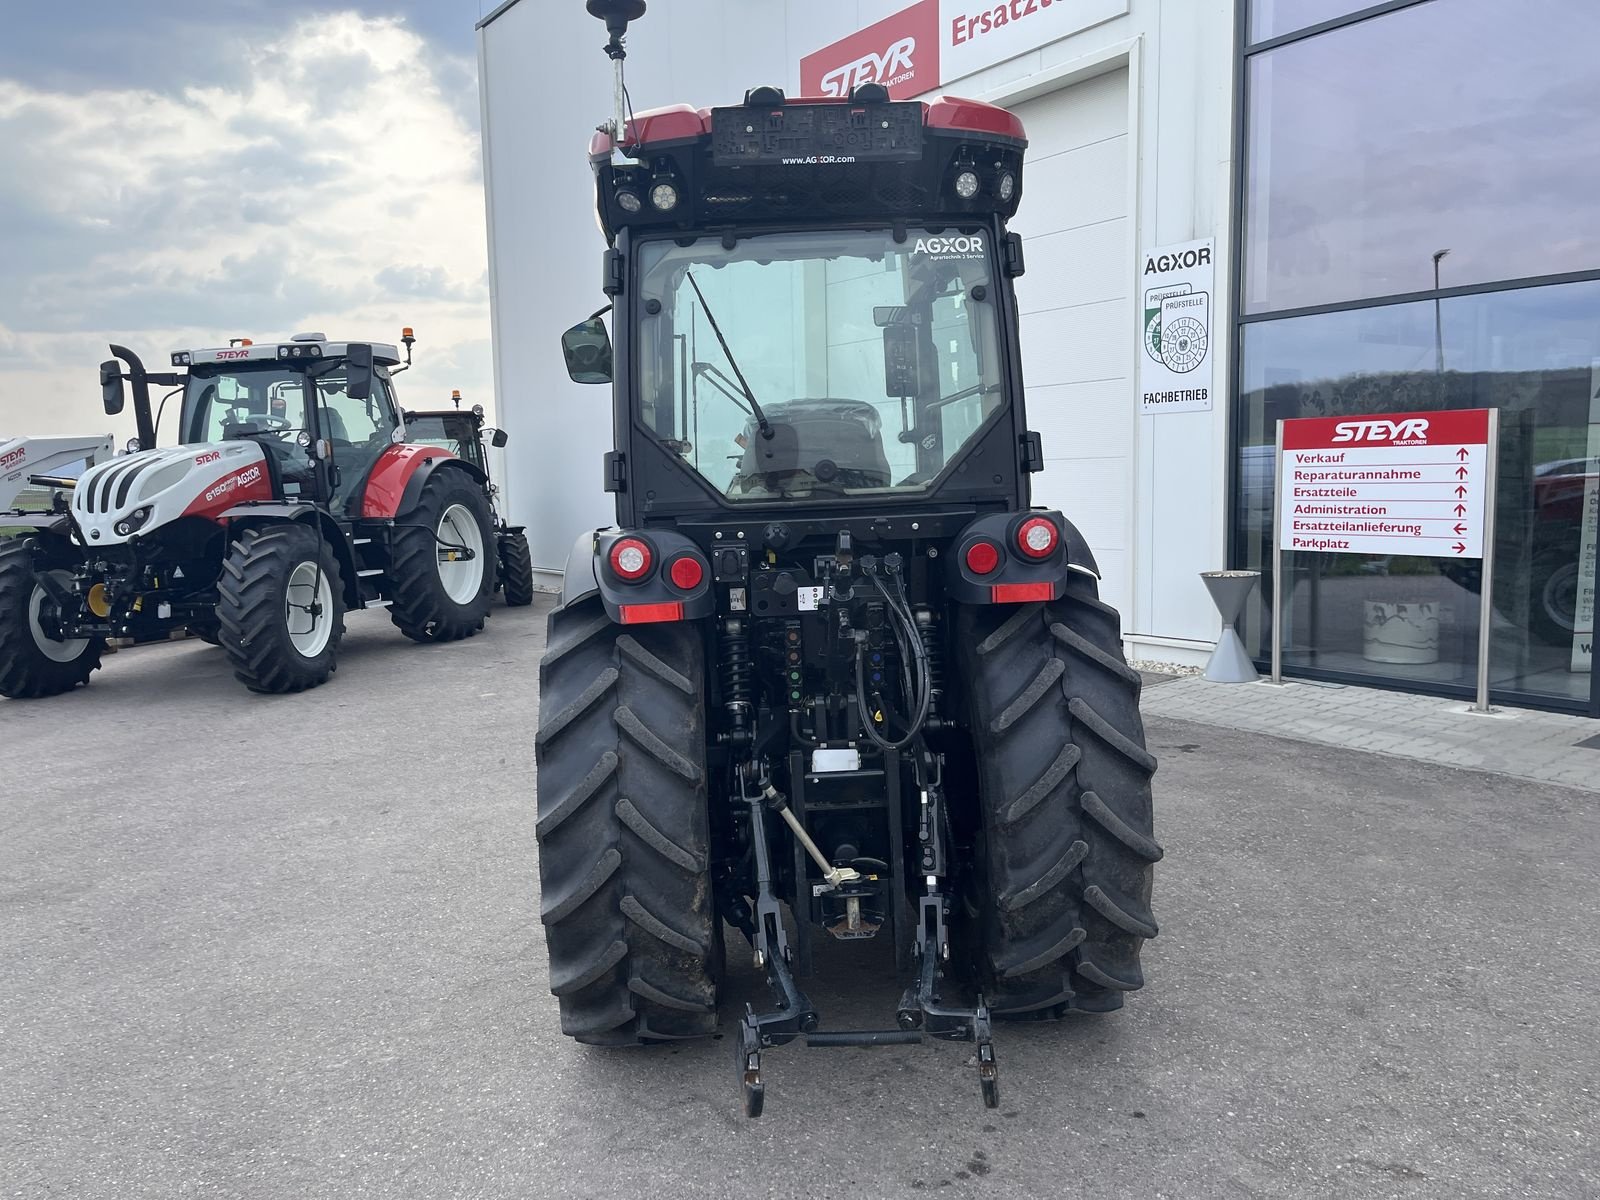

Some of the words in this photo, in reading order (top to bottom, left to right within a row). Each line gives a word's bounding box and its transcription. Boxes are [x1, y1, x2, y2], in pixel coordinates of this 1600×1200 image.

[821, 36, 915, 97] STEYR
[881, 70, 915, 87] RAKTOREN
[914, 237, 983, 254] AGXOR
[1144, 247, 1211, 275] AGXOR
[1165, 297, 1204, 310] PRÜFSTELLE
[216, 350, 249, 360] STEYR
[1143, 388, 1208, 404] FACHBETRIEB
[1331, 418, 1429, 442] STEYR
[0, 447, 26, 466] STEYR
[195, 451, 221, 465] STEYR
[1296, 452, 1345, 463] Verkauf
[237, 466, 261, 487] AGXOR
[1294, 470, 1421, 482] Reparaturannahme
[205, 483, 226, 502] 6150
[1294, 487, 1357, 497] Ersatzteile
[1294, 504, 1387, 515] Administration
[1293, 520, 1422, 536] Ersatzteilanlieferung
[1292, 537, 1350, 551] Parkplatz
